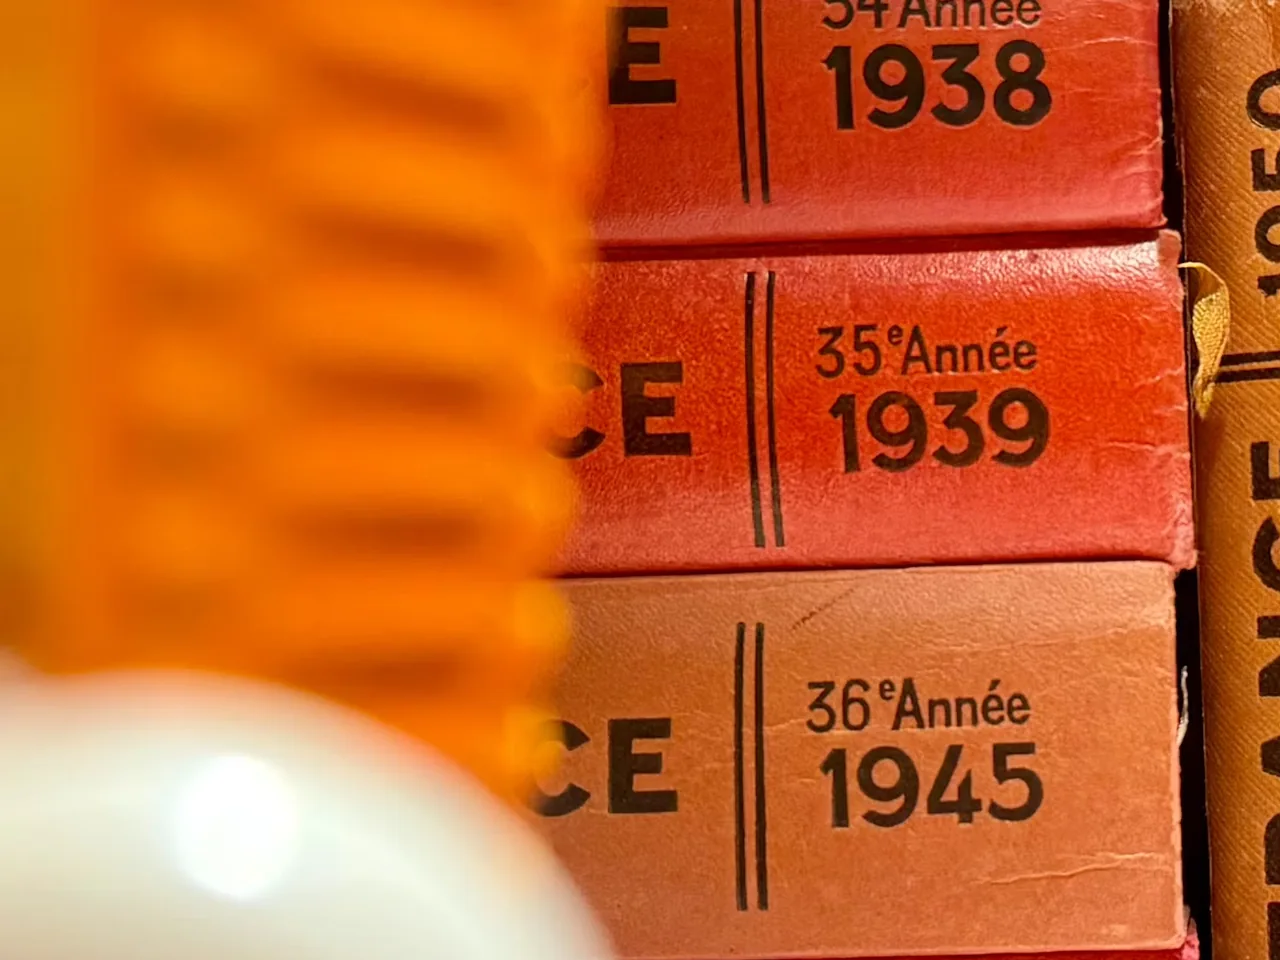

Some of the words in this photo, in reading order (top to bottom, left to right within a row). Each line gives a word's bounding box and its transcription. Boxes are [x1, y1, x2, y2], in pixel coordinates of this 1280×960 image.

[821, 40, 1053, 130] 1938
[900, 326, 1038, 376] Année
[828, 386, 1051, 474] 1939
[890, 677, 1031, 731] Année
[818, 741, 1046, 829] 1945
